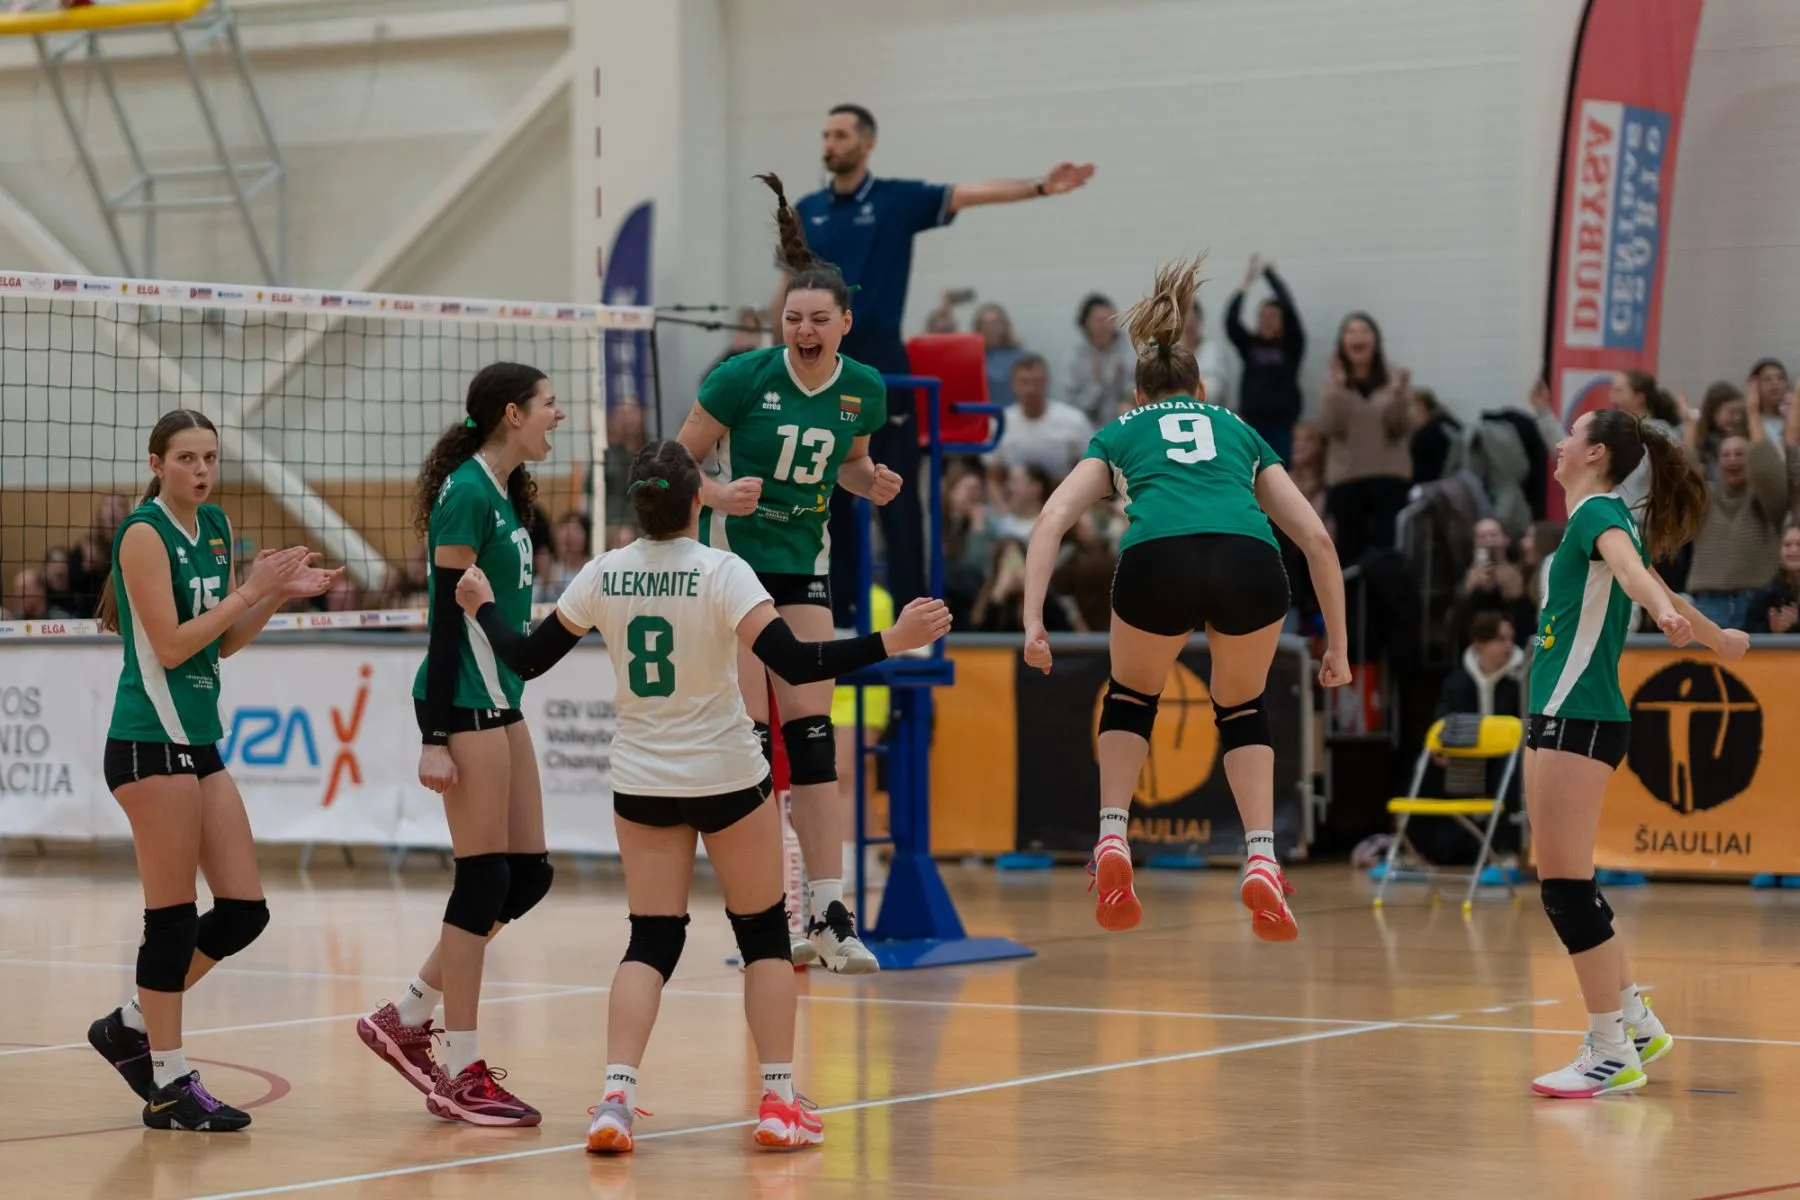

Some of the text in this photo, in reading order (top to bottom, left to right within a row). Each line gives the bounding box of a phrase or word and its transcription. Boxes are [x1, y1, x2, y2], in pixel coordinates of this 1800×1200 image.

[137, 284, 160, 295] ELGA
[840, 411, 857, 422] LTU
[1118, 401, 1245, 426] KUODAITY
[773, 424, 836, 484] 13
[1158, 413, 1217, 464] 9
[189, 576, 221, 618] 15
[602, 568, 701, 598] ALEKNAITĖ
[41, 624, 66, 634] ELGA
[627, 615, 676, 698] 8
[0, 686, 42, 717] OS
[0, 762, 74, 798] CIJA
[1127, 818, 1213, 844] AULIAI
[1634, 824, 1751, 855] ŠIAULIAI
